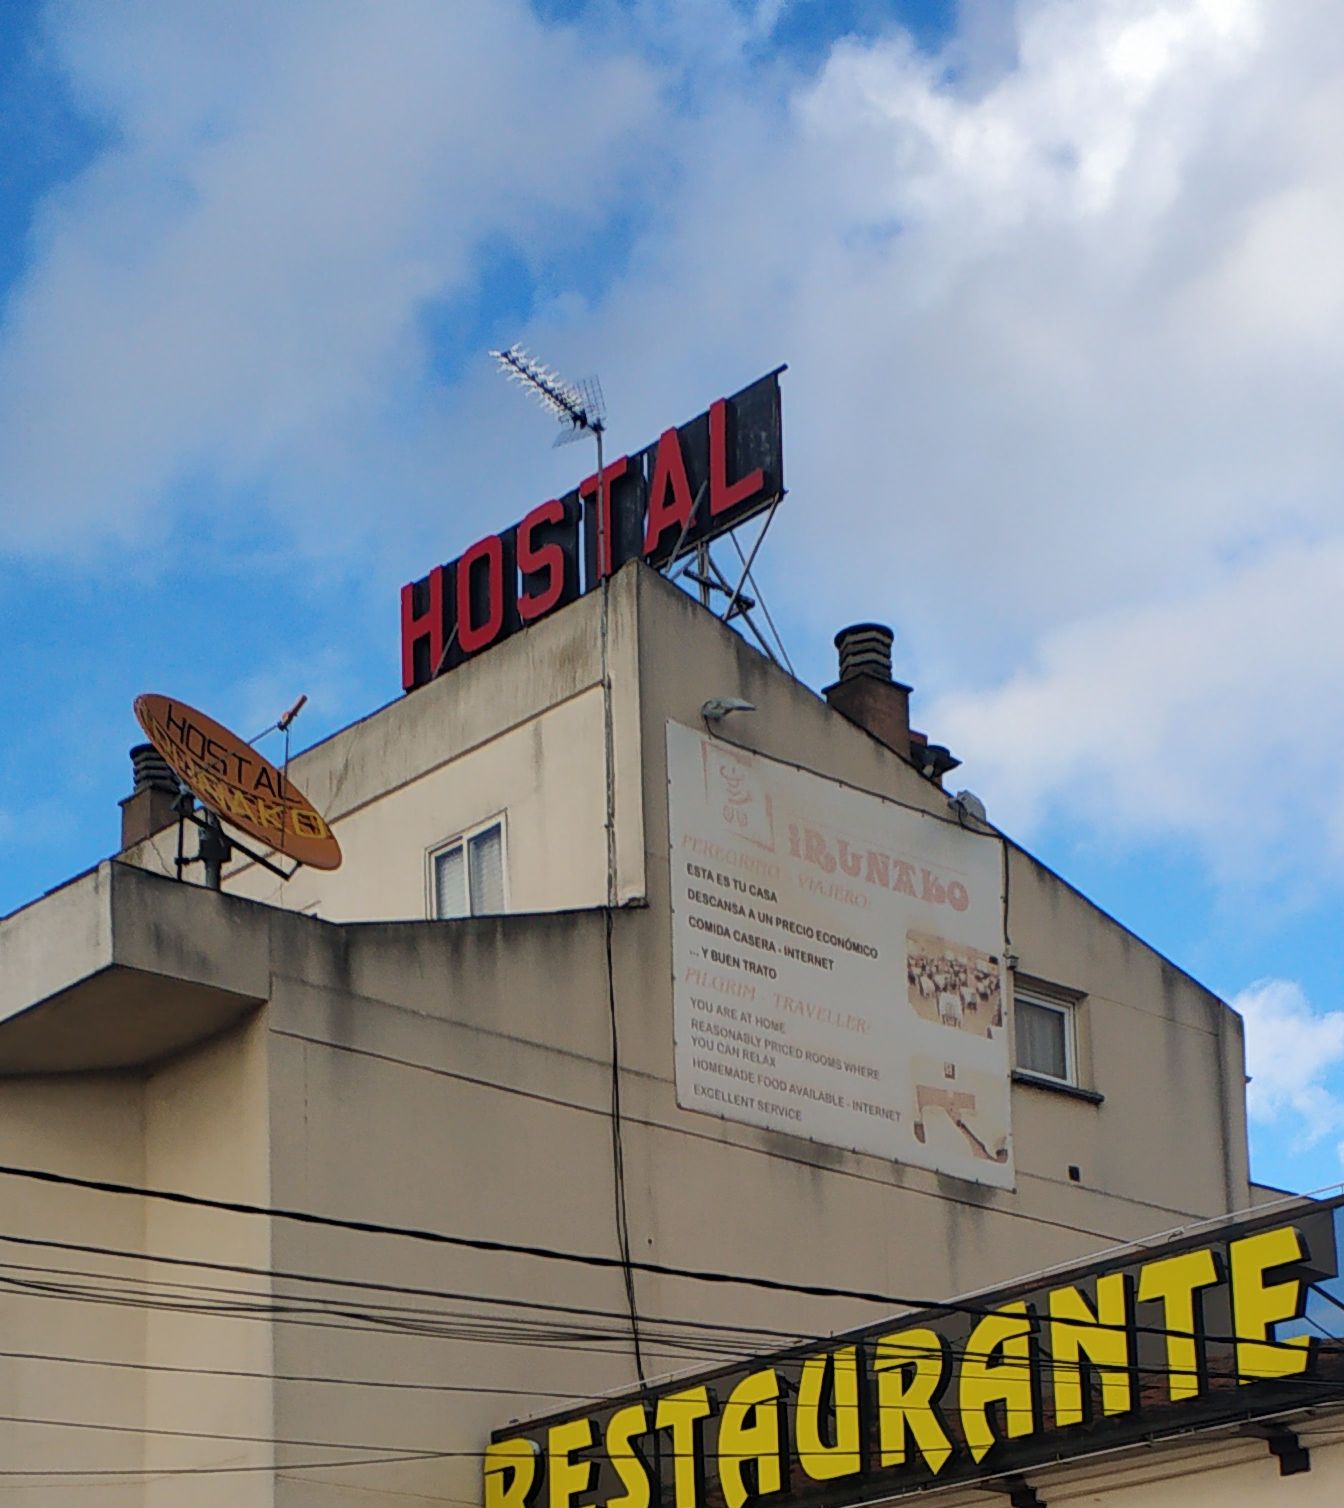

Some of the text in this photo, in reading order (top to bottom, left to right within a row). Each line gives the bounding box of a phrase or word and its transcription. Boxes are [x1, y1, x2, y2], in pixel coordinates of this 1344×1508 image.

[400, 397, 764, 690] HOSTAL
[166, 703, 302, 805] HOSTAL
[687, 863, 778, 903] ESTA ES TU CASA
[687, 888, 878, 959] DESCANSA A UN PRECIO ECONÓMICO
[688, 915, 730, 939] COMIDA
[733, 930, 776, 953] CASERA
[784, 946, 834, 971] INTERNET
[685, 967, 756, 1000] PILGRIM
[711, 950, 740, 969] BUEN
[743, 959, 777, 979] TRATO
[690, 997, 785, 1034] YOU ARE AT HOME
[691, 1018, 880, 1080] REASONABLY PRICED ROOMS WHERE
[691, 1036, 776, 1068] YOU CAN RELAX
[692, 1056, 755, 1084] HOMEMADE
[757, 1073, 787, 1092] FOOD
[789, 1083, 845, 1108] AVAILABLE
[852, 1102, 902, 1122] INTERNET
[693, 1083, 802, 1121] EXCELLENT SERVICE
